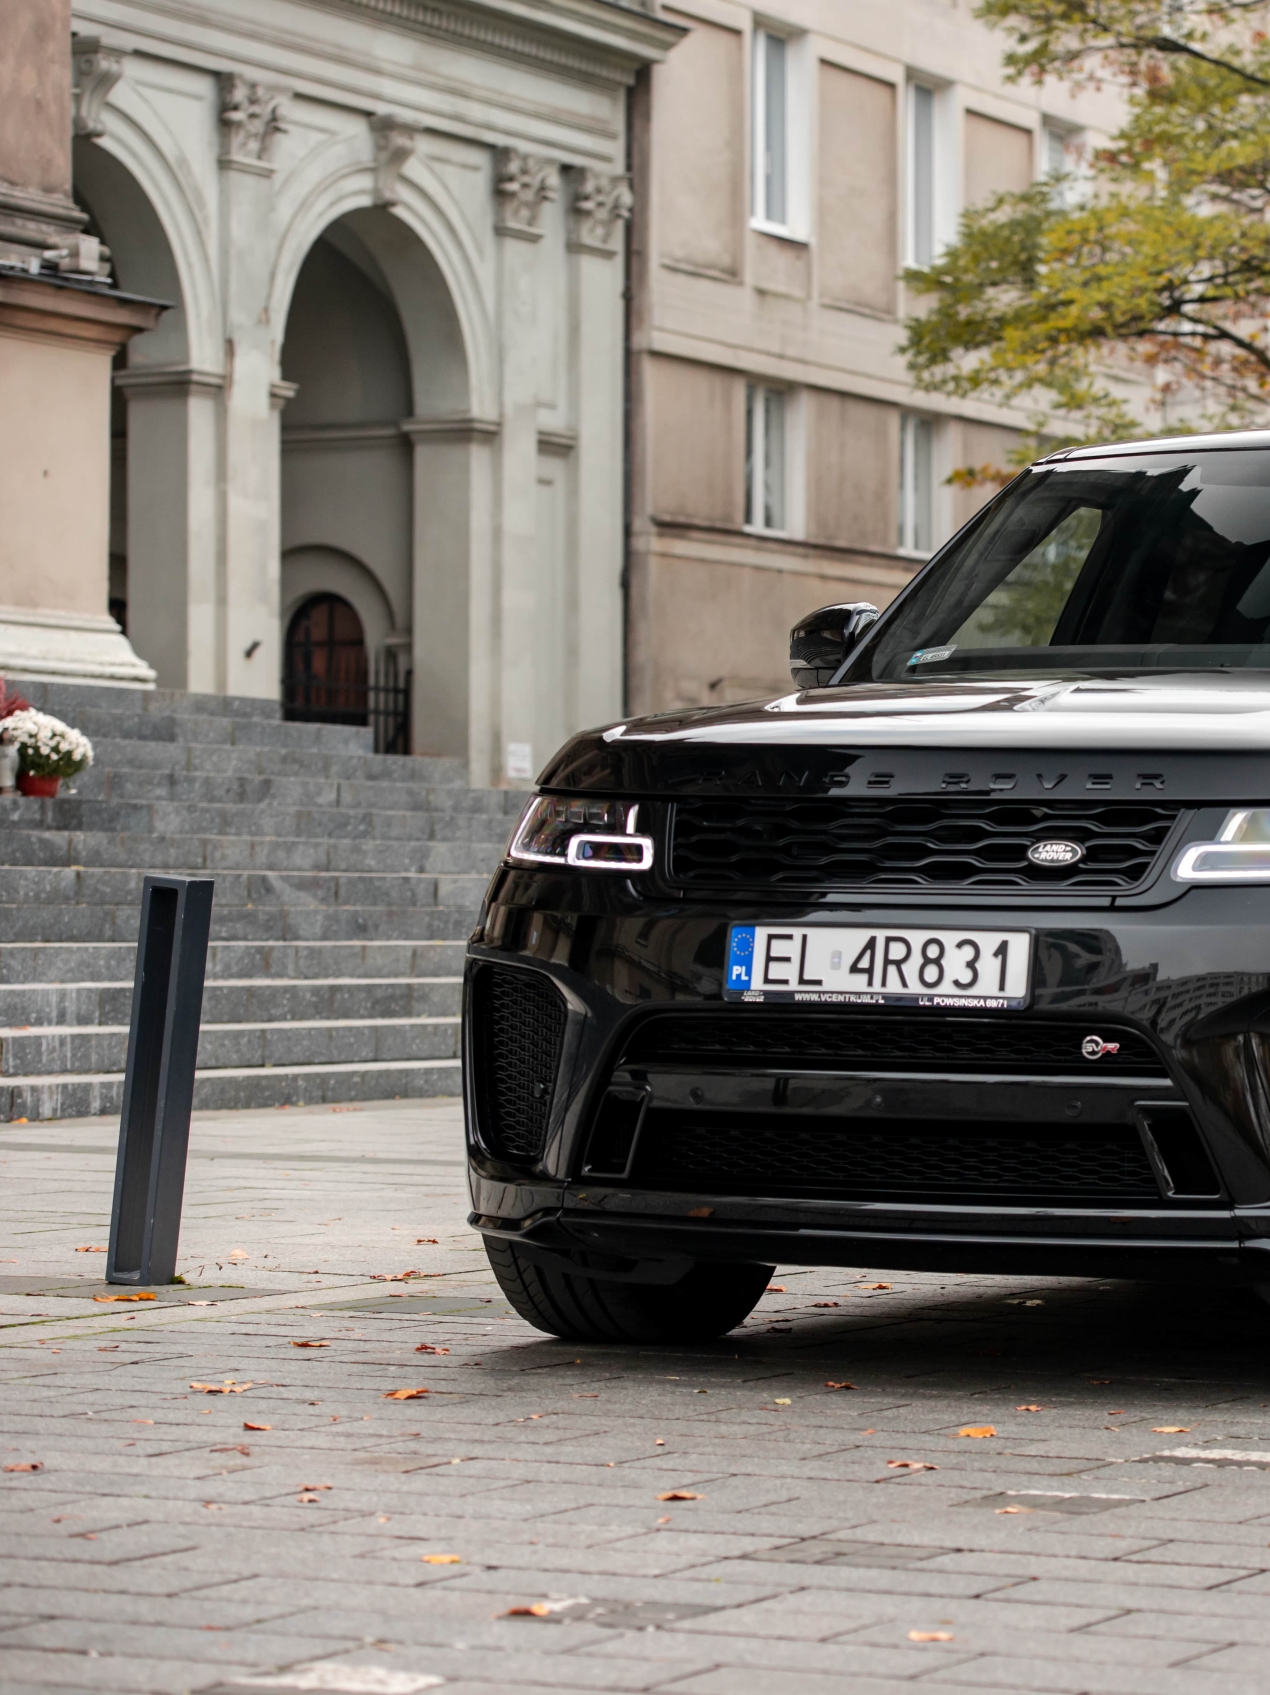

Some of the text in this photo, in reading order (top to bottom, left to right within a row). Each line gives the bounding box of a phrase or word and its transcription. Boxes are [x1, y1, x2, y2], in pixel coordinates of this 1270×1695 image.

[698, 769, 1165, 790] RANGE ROVER
[763, 934, 1009, 992] EL 4R831
[732, 965, 749, 980] PL
[794, 993, 884, 1003] WWW.VCENTRUM.PL
[918, 997, 932, 1005] UL.
